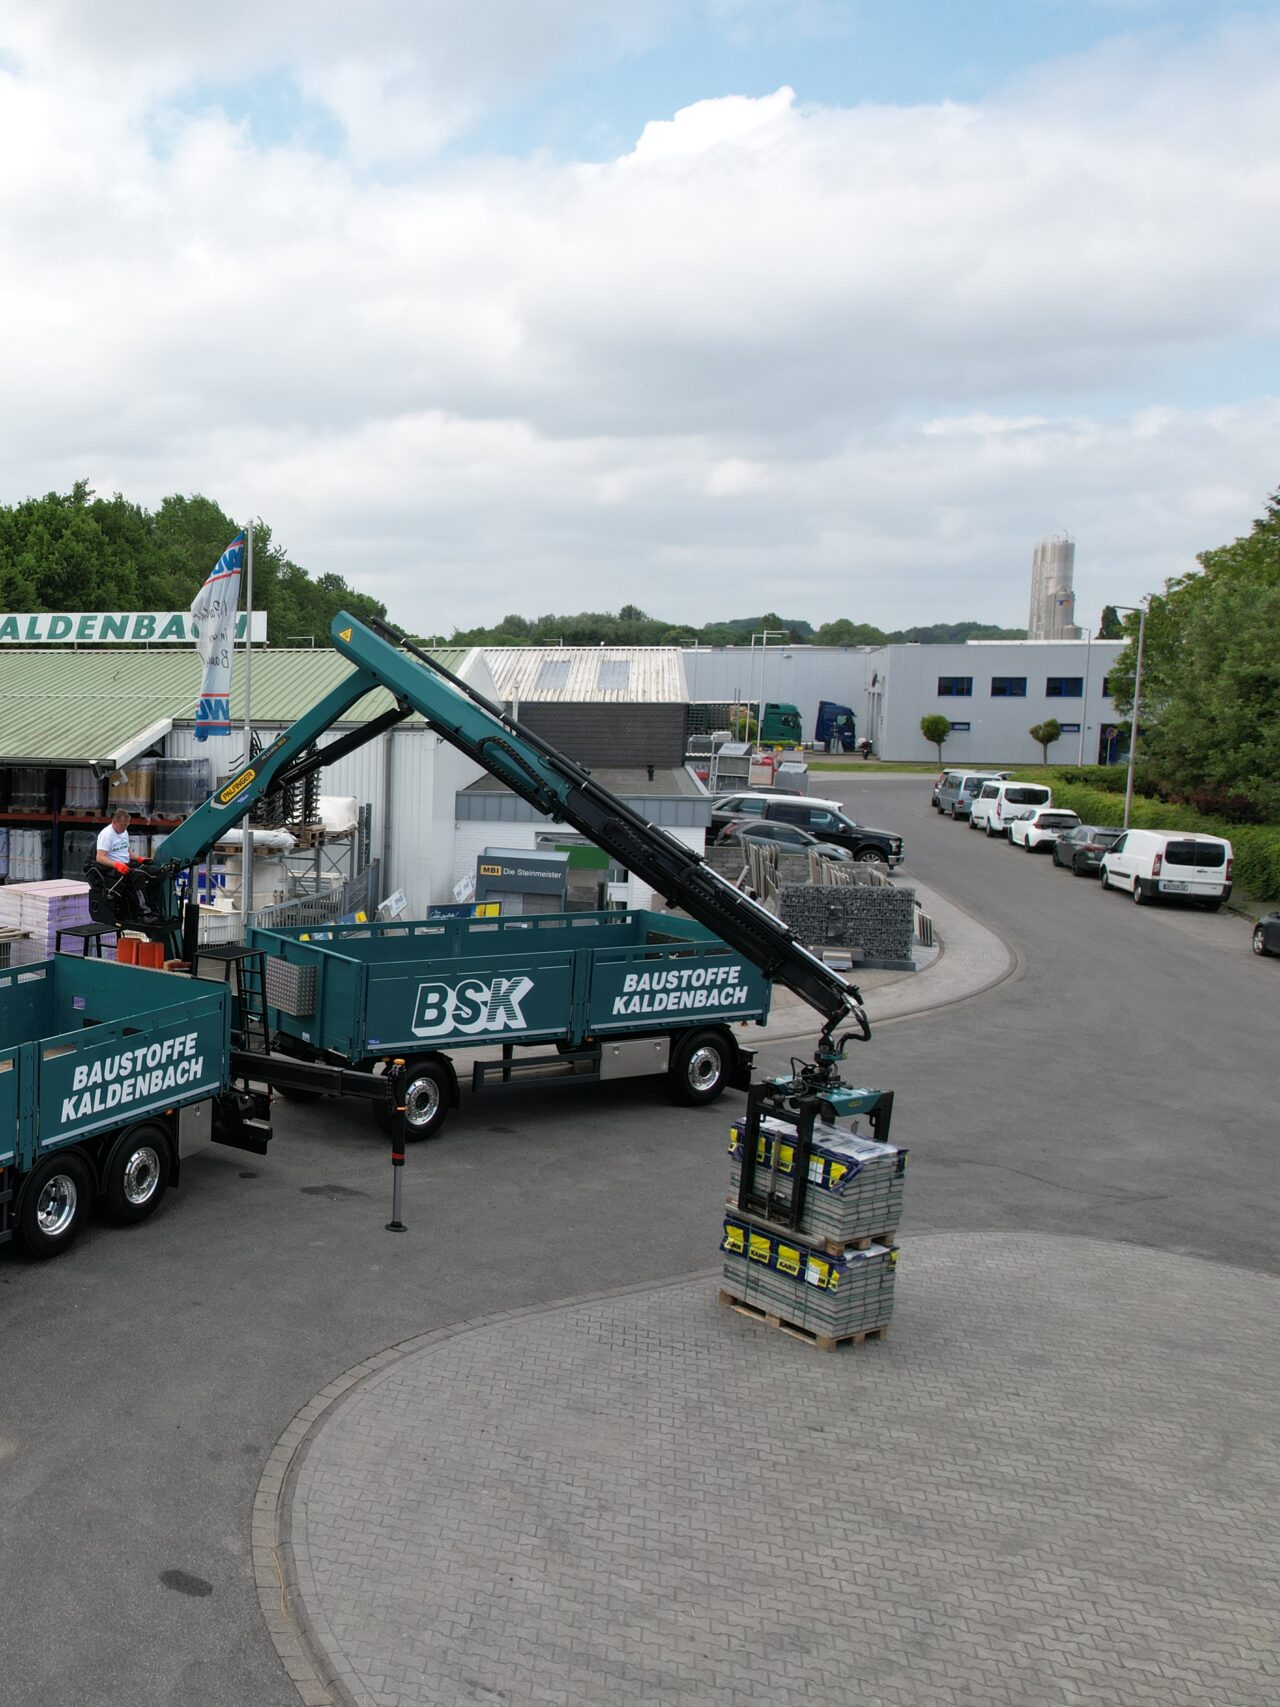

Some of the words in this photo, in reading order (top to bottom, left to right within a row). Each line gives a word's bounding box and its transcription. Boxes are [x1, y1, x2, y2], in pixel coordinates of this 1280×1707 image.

[222, 770, 254, 800] PALFINGER
[482, 866, 500, 874] MBI
[503, 868, 516, 876] Die
[517, 868, 562, 879] Steinmeister
[623, 966, 741, 993] BAUSTOFFE
[411, 976, 534, 1037] BSK
[612, 985, 748, 1015] KALDENBACH
[72, 1032, 198, 1092] BAUSTOFFE
[60, 1056, 204, 1123] KALDENBACH
[750, 1249, 768, 1261] KANN
[779, 1261, 797, 1273] KANN
